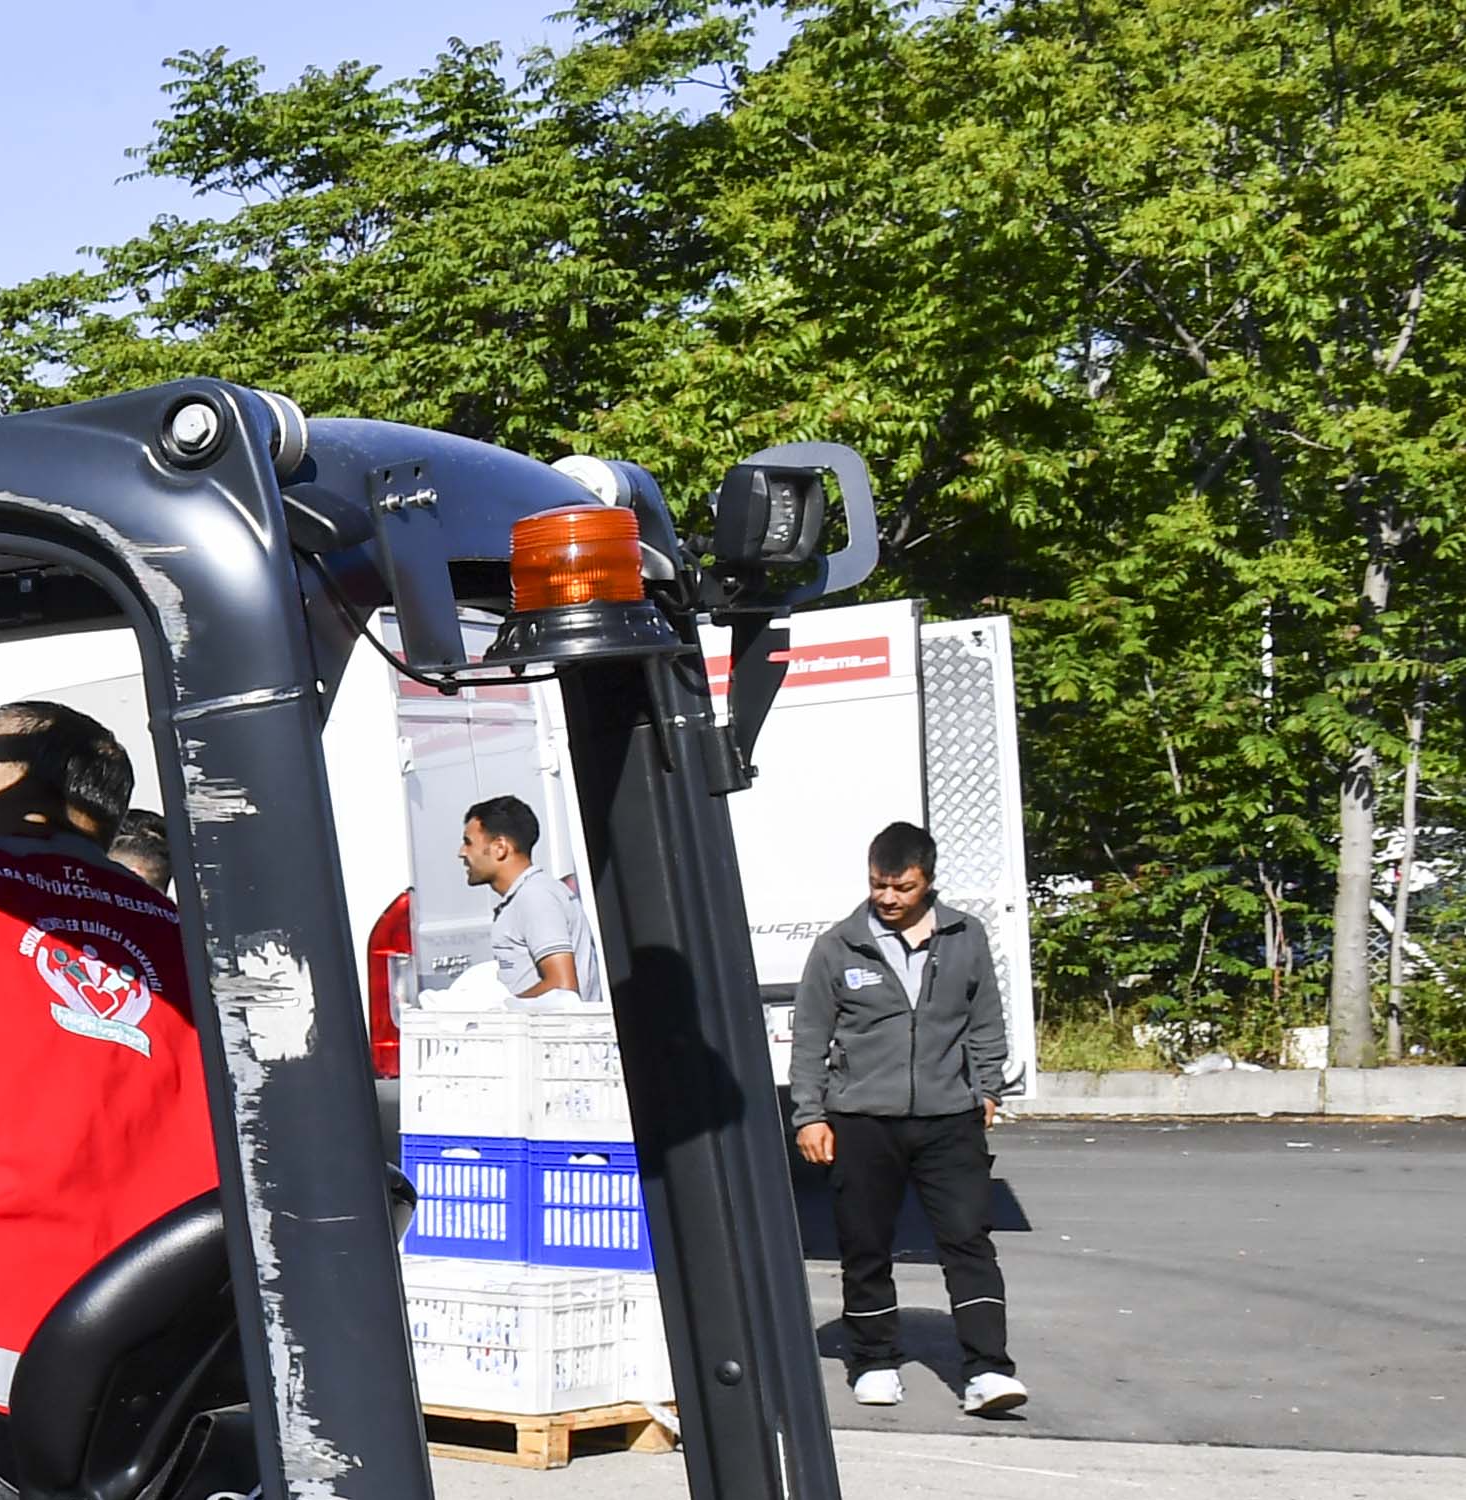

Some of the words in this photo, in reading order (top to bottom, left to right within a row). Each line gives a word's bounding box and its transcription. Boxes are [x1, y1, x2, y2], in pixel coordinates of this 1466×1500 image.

[787, 655, 887, 676] kiralama.com
[62, 865, 90, 884] T.C.
[750, 921, 840, 935] UCAT
